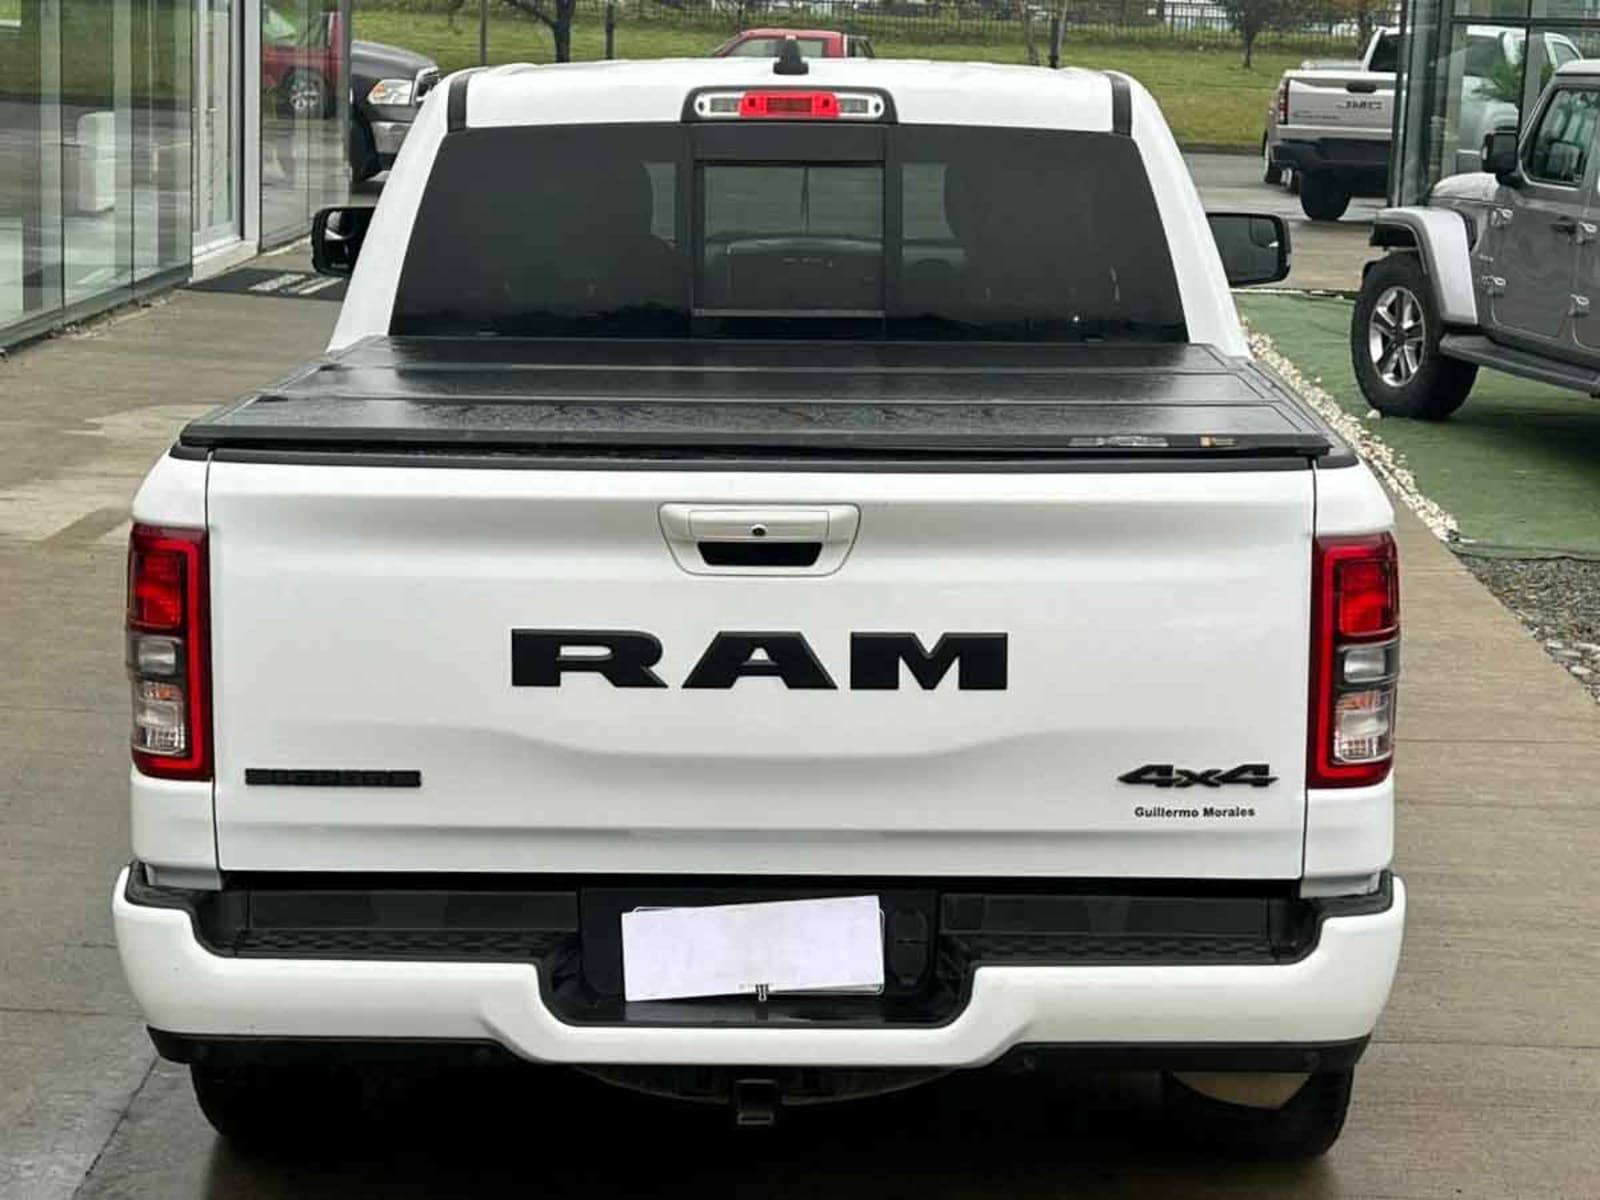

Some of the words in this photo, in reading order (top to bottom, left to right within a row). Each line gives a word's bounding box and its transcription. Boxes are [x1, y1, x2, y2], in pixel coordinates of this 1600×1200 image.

[511, 629, 1008, 691] RAM
[1134, 806, 1199, 818] Guillermo
[1202, 806, 1256, 817] Morales
